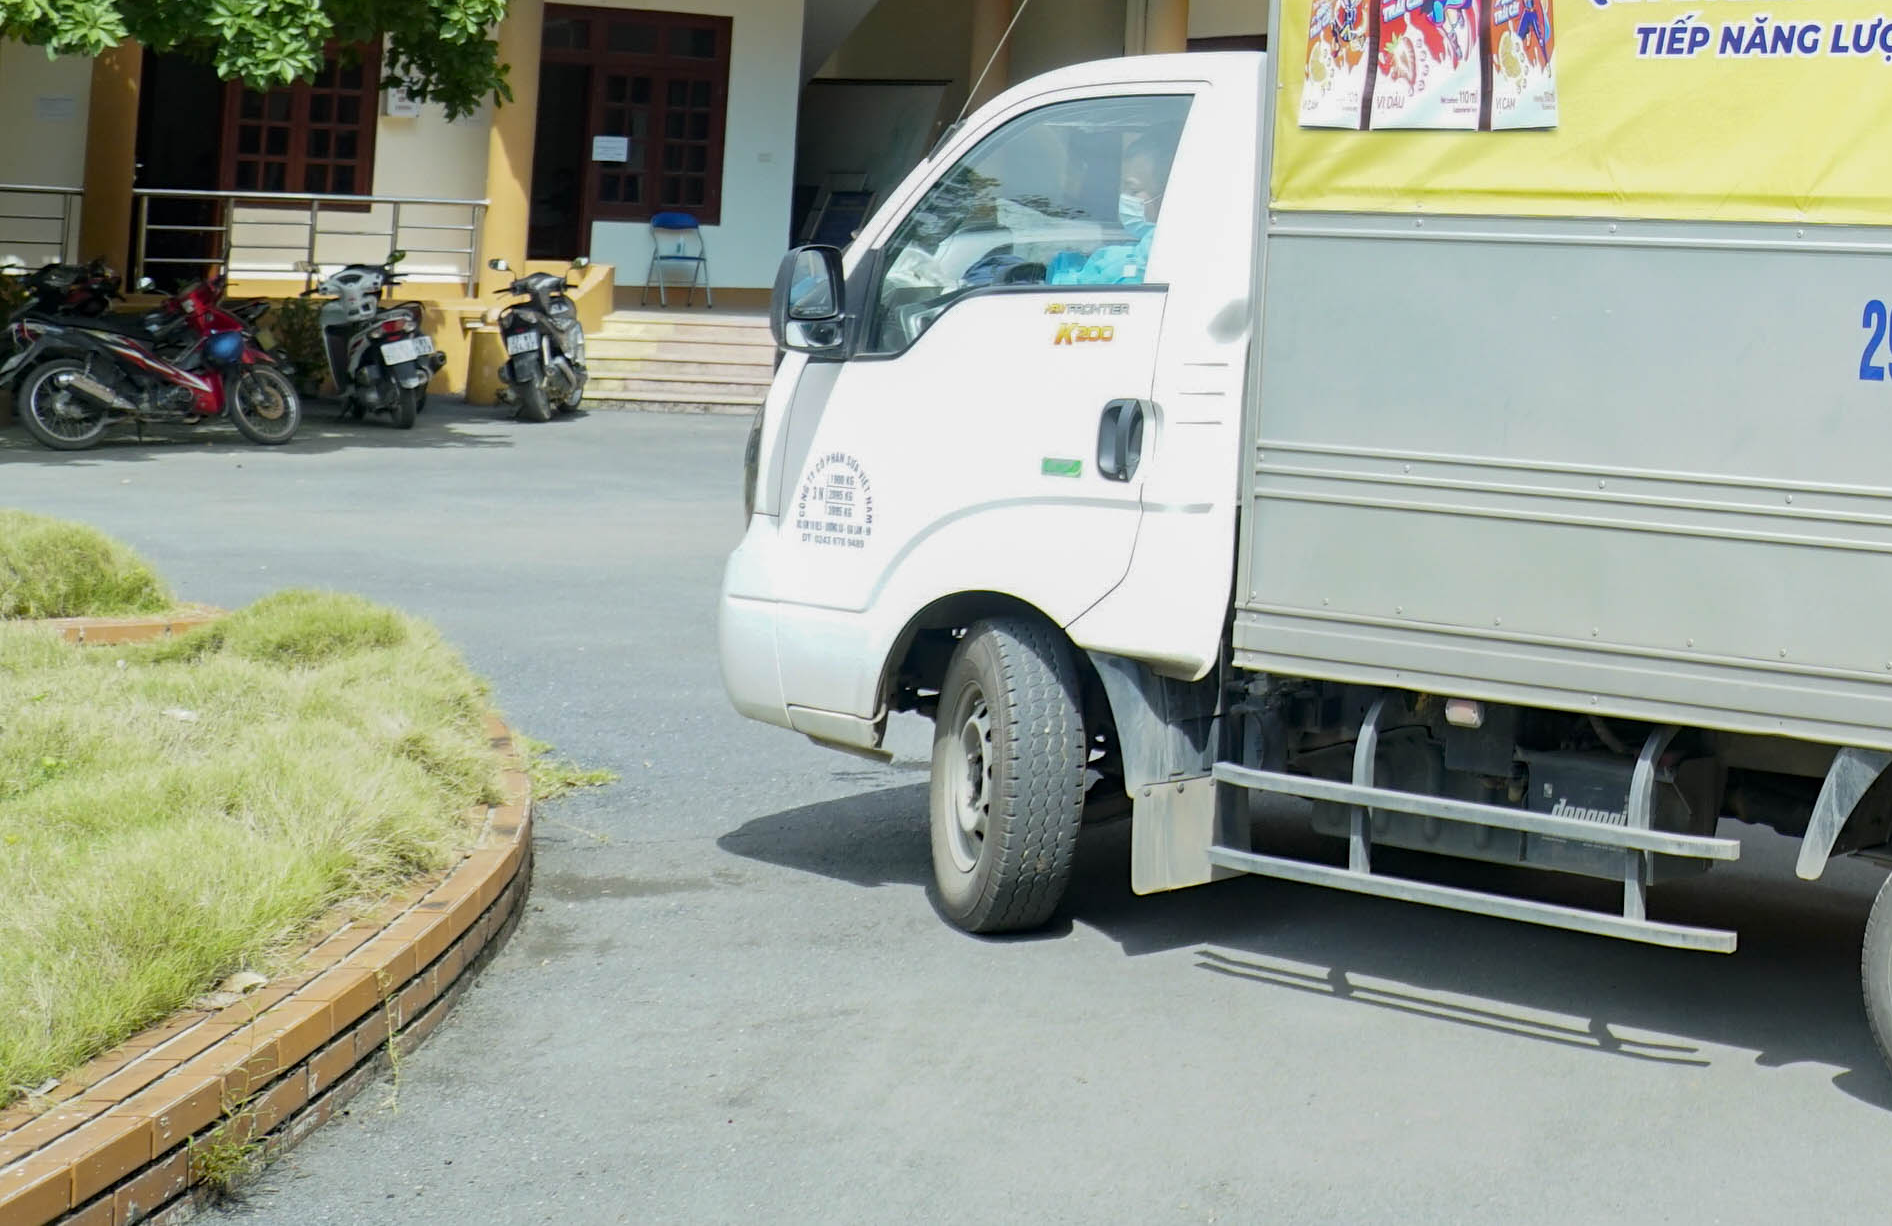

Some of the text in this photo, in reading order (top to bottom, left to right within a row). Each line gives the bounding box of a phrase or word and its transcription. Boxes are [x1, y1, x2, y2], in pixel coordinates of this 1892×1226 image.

[1637, 13, 1709, 55] TIẾP
[1719, 17, 1821, 54] NĂNG
[1054, 322, 1114, 345] K200
